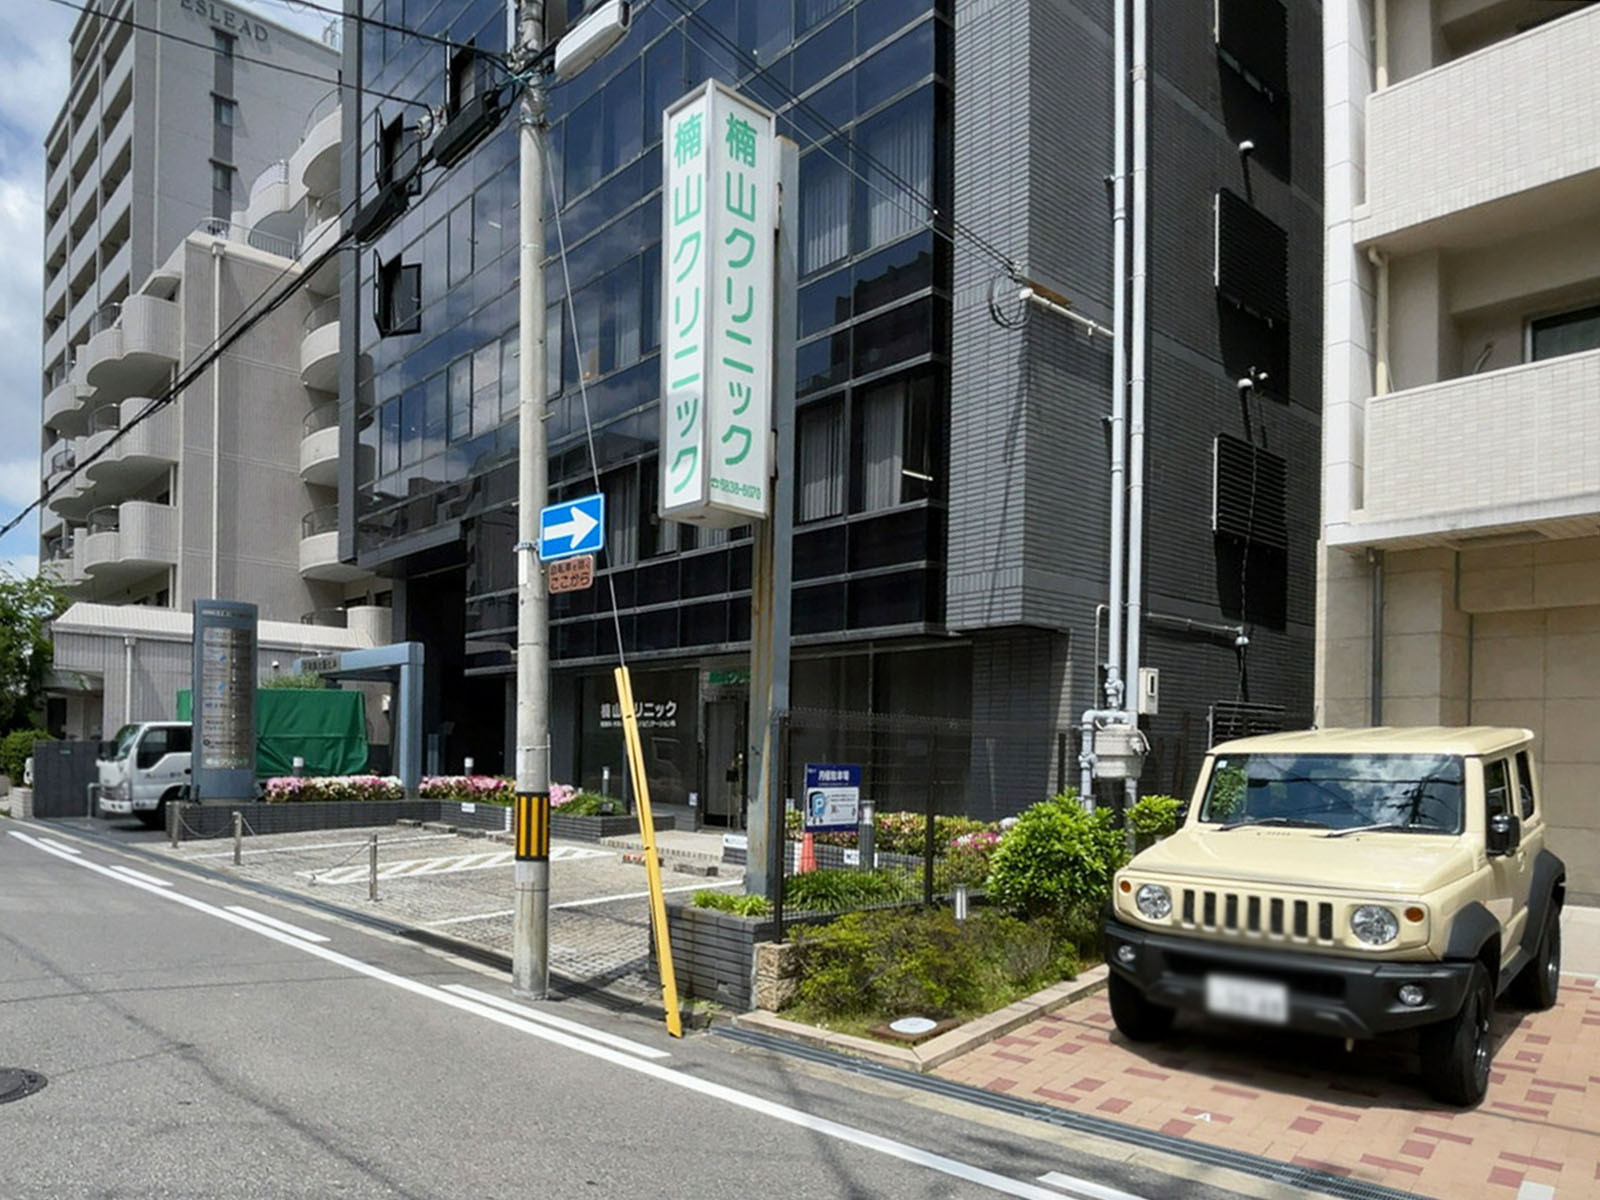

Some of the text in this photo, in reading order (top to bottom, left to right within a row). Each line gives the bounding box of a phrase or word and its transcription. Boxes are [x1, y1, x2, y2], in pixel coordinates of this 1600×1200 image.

[672, 112, 703, 493] 楠山クリニック
[722, 112, 757, 465] 楠山クリニック
[550, 572, 590, 590] ここから
[601, 701, 677, 718] 山リニック
